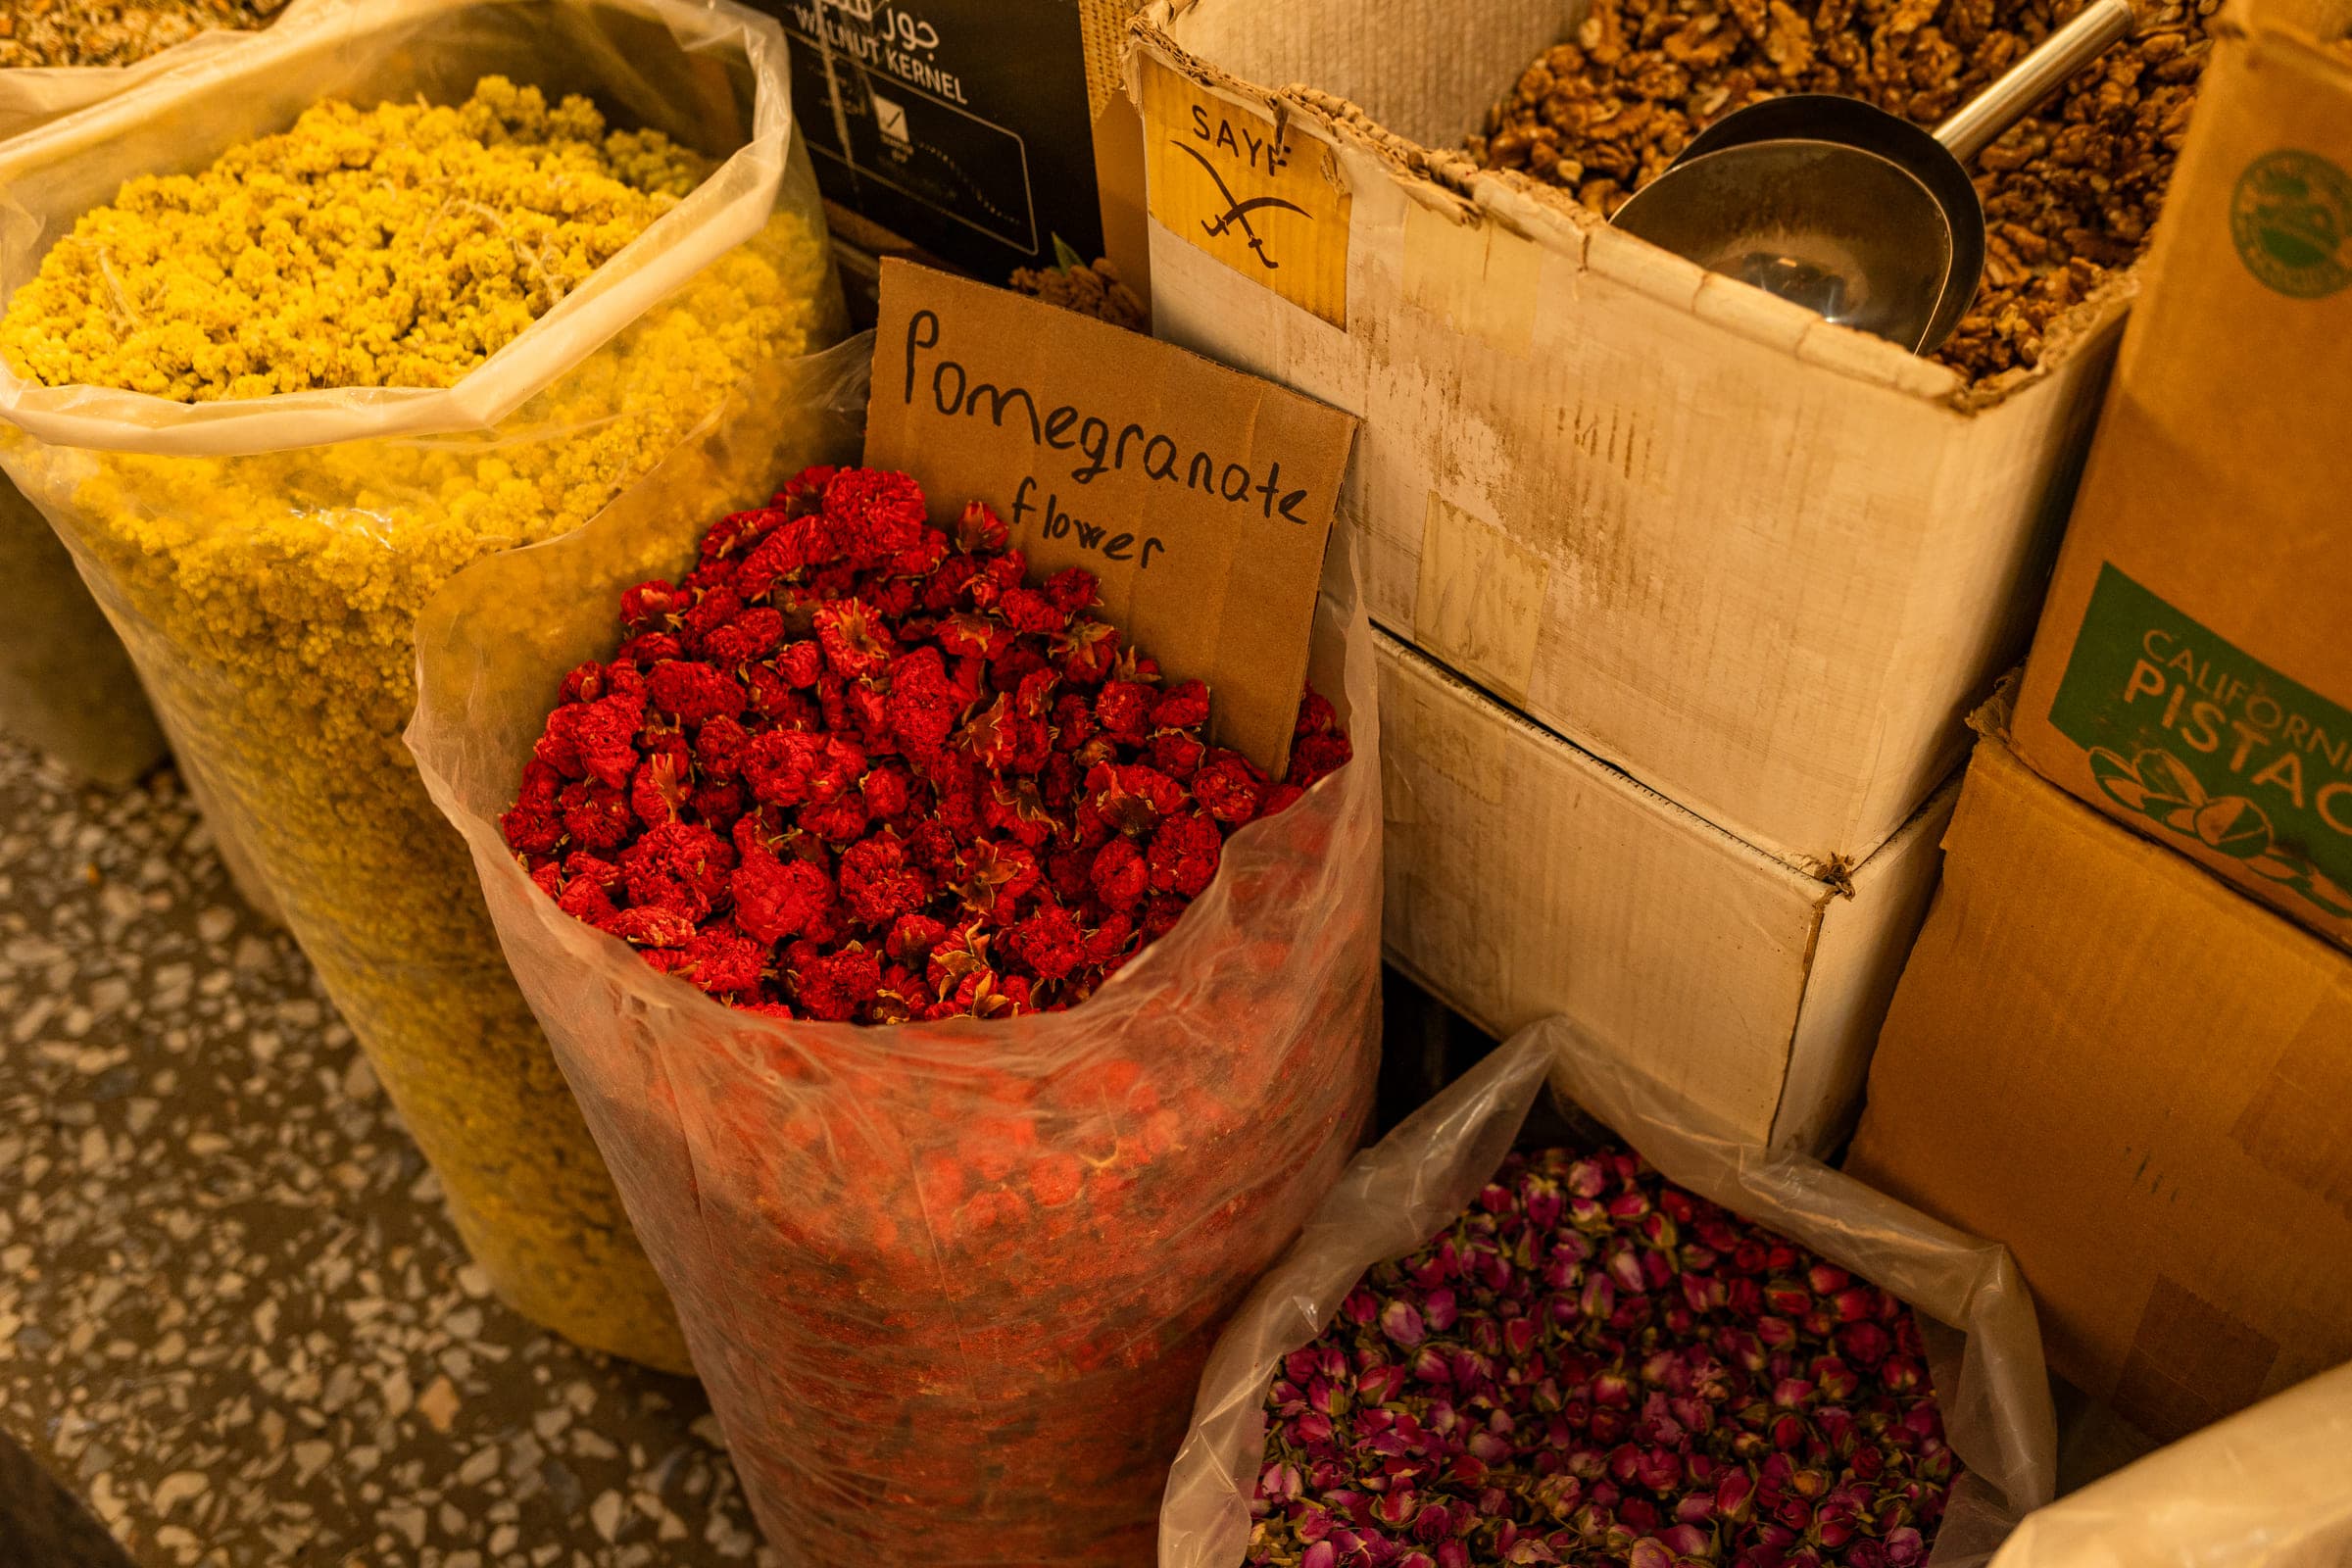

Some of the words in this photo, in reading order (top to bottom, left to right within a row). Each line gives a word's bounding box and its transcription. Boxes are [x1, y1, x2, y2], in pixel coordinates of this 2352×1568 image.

[885, 45, 968, 105] KERNEL
[1192, 104, 1292, 176] SAYF
[905, 310, 1309, 525] Pomegranate
[1012, 476, 1165, 569] flower
[2124, 658, 2352, 836] PISTAC
